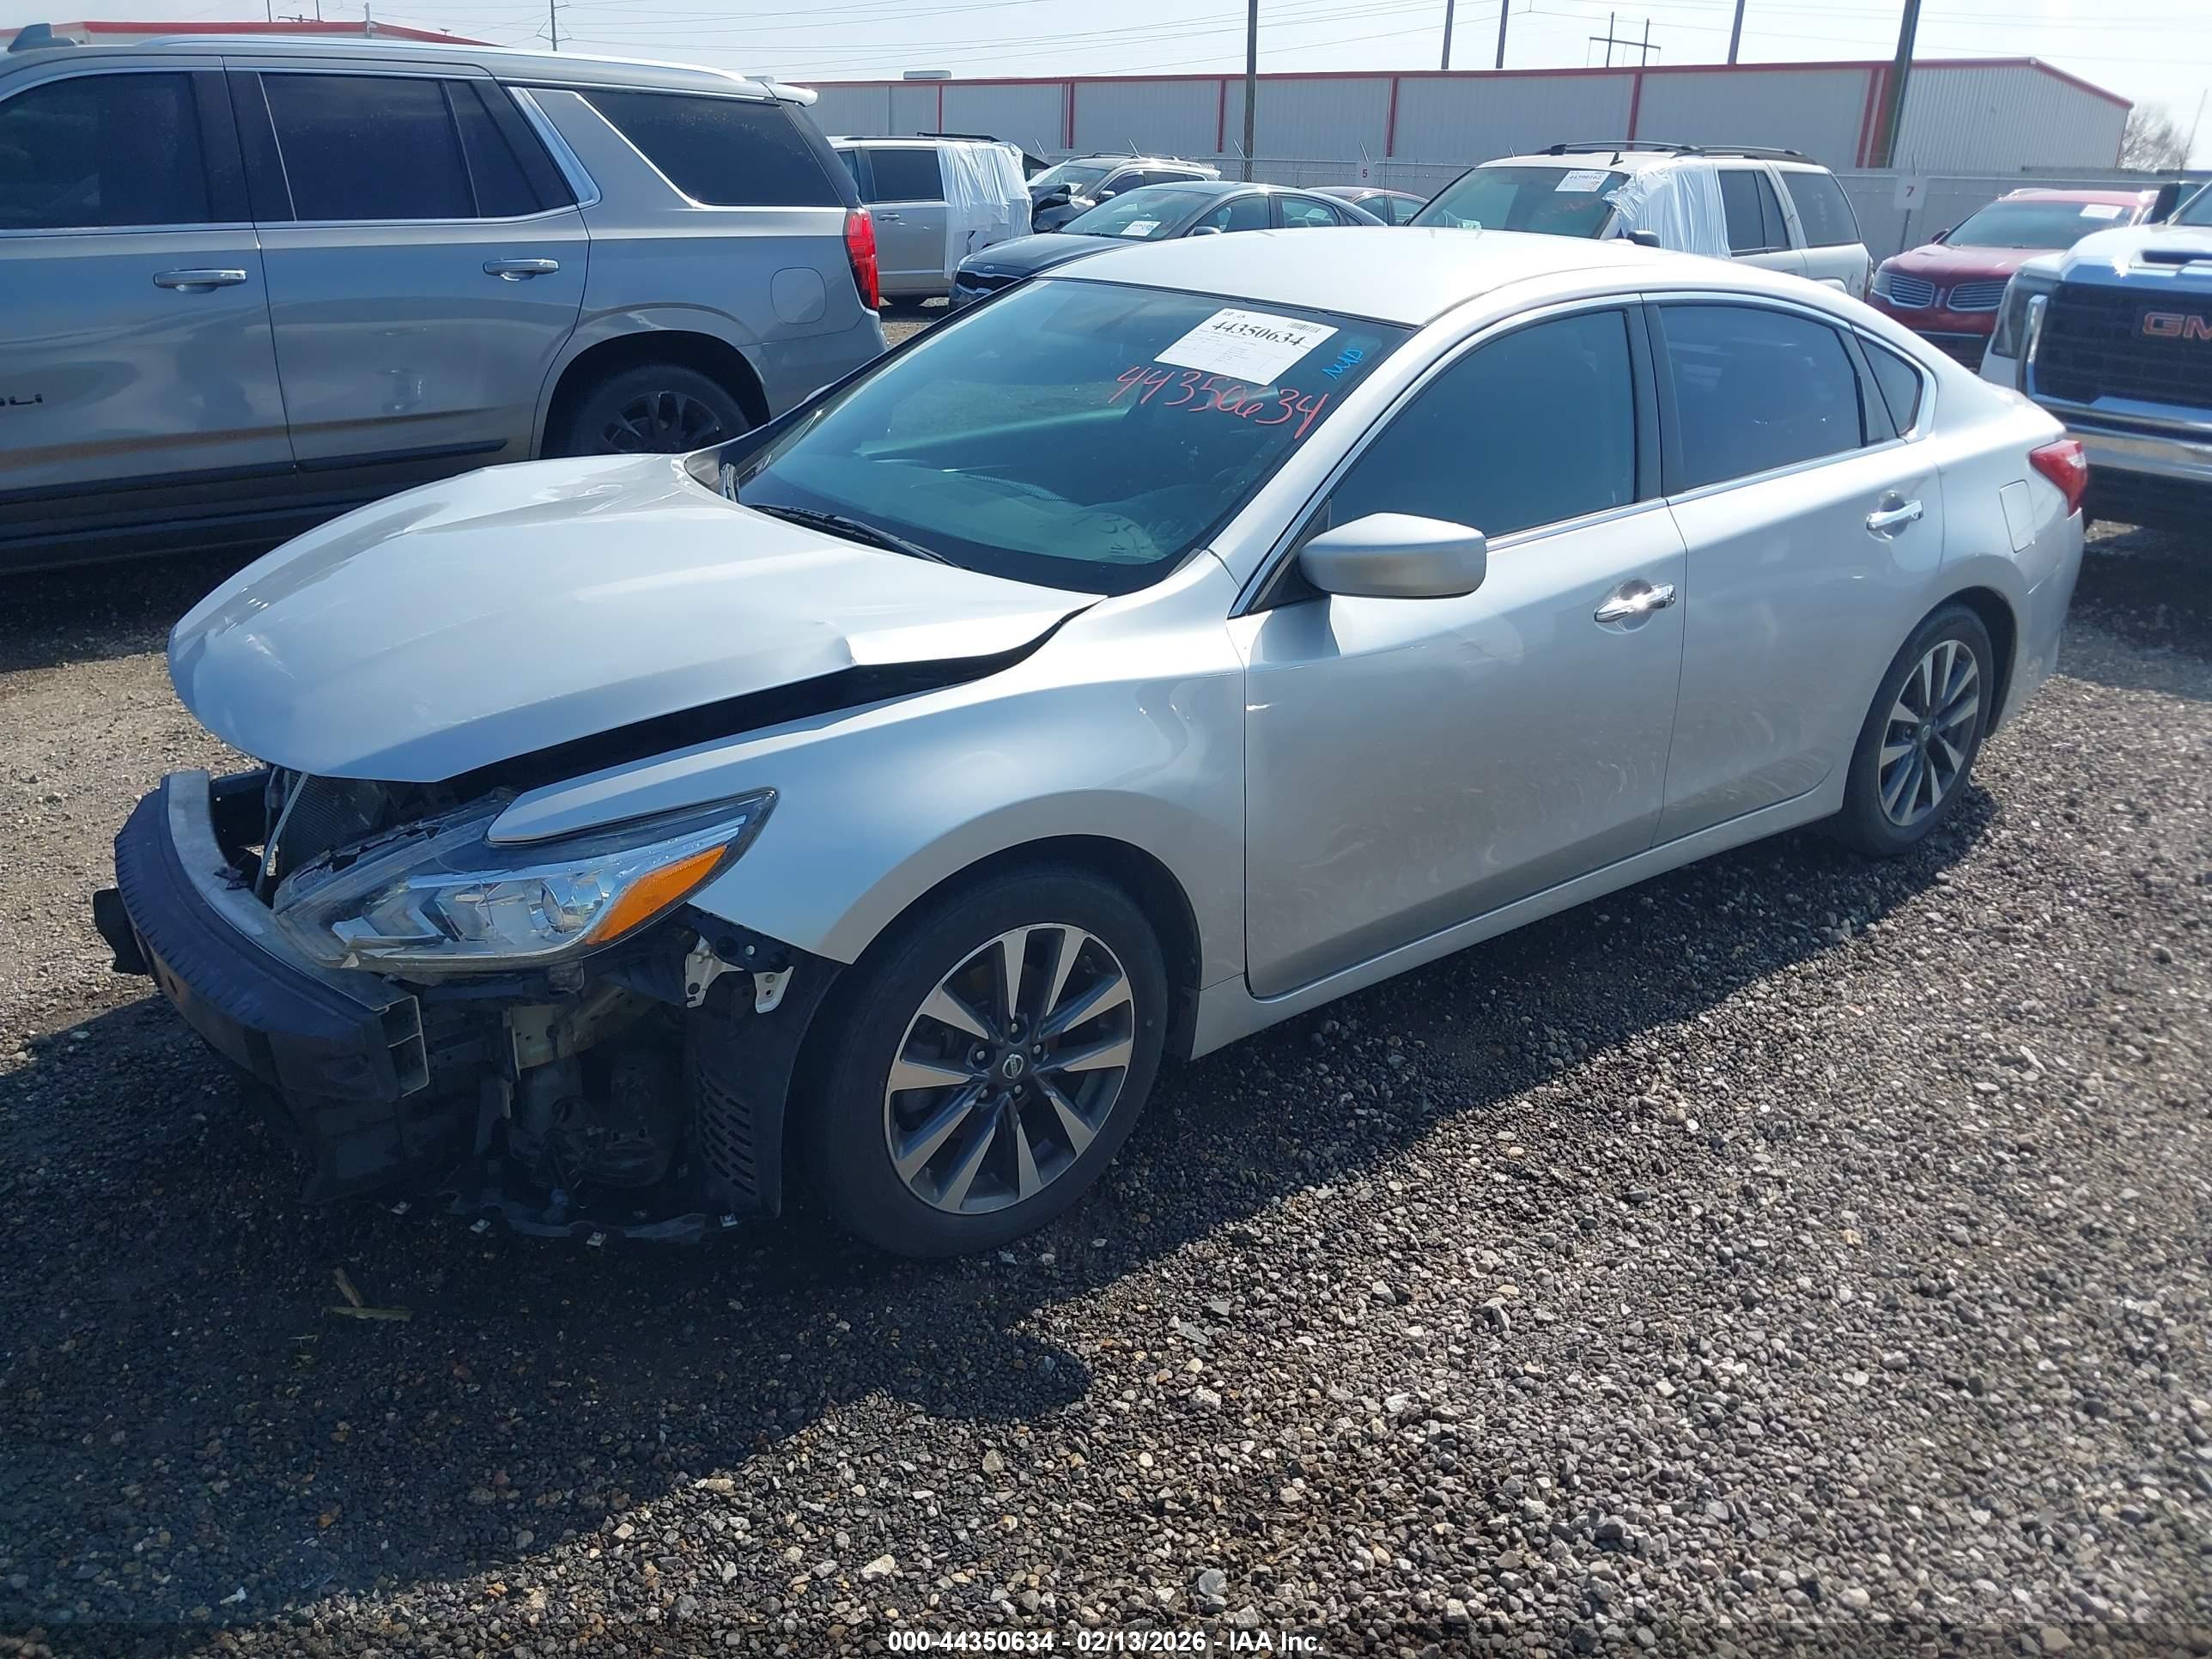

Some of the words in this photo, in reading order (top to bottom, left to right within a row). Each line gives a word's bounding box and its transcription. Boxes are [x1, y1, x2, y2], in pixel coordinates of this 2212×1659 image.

[1362, 168, 1368, 178] 5
[1905, 185, 1916, 198] 7
[1212, 320, 1307, 346] 44350634
[2142, 311, 2212, 340] GM
[1107, 365, 1329, 440] 44350634
